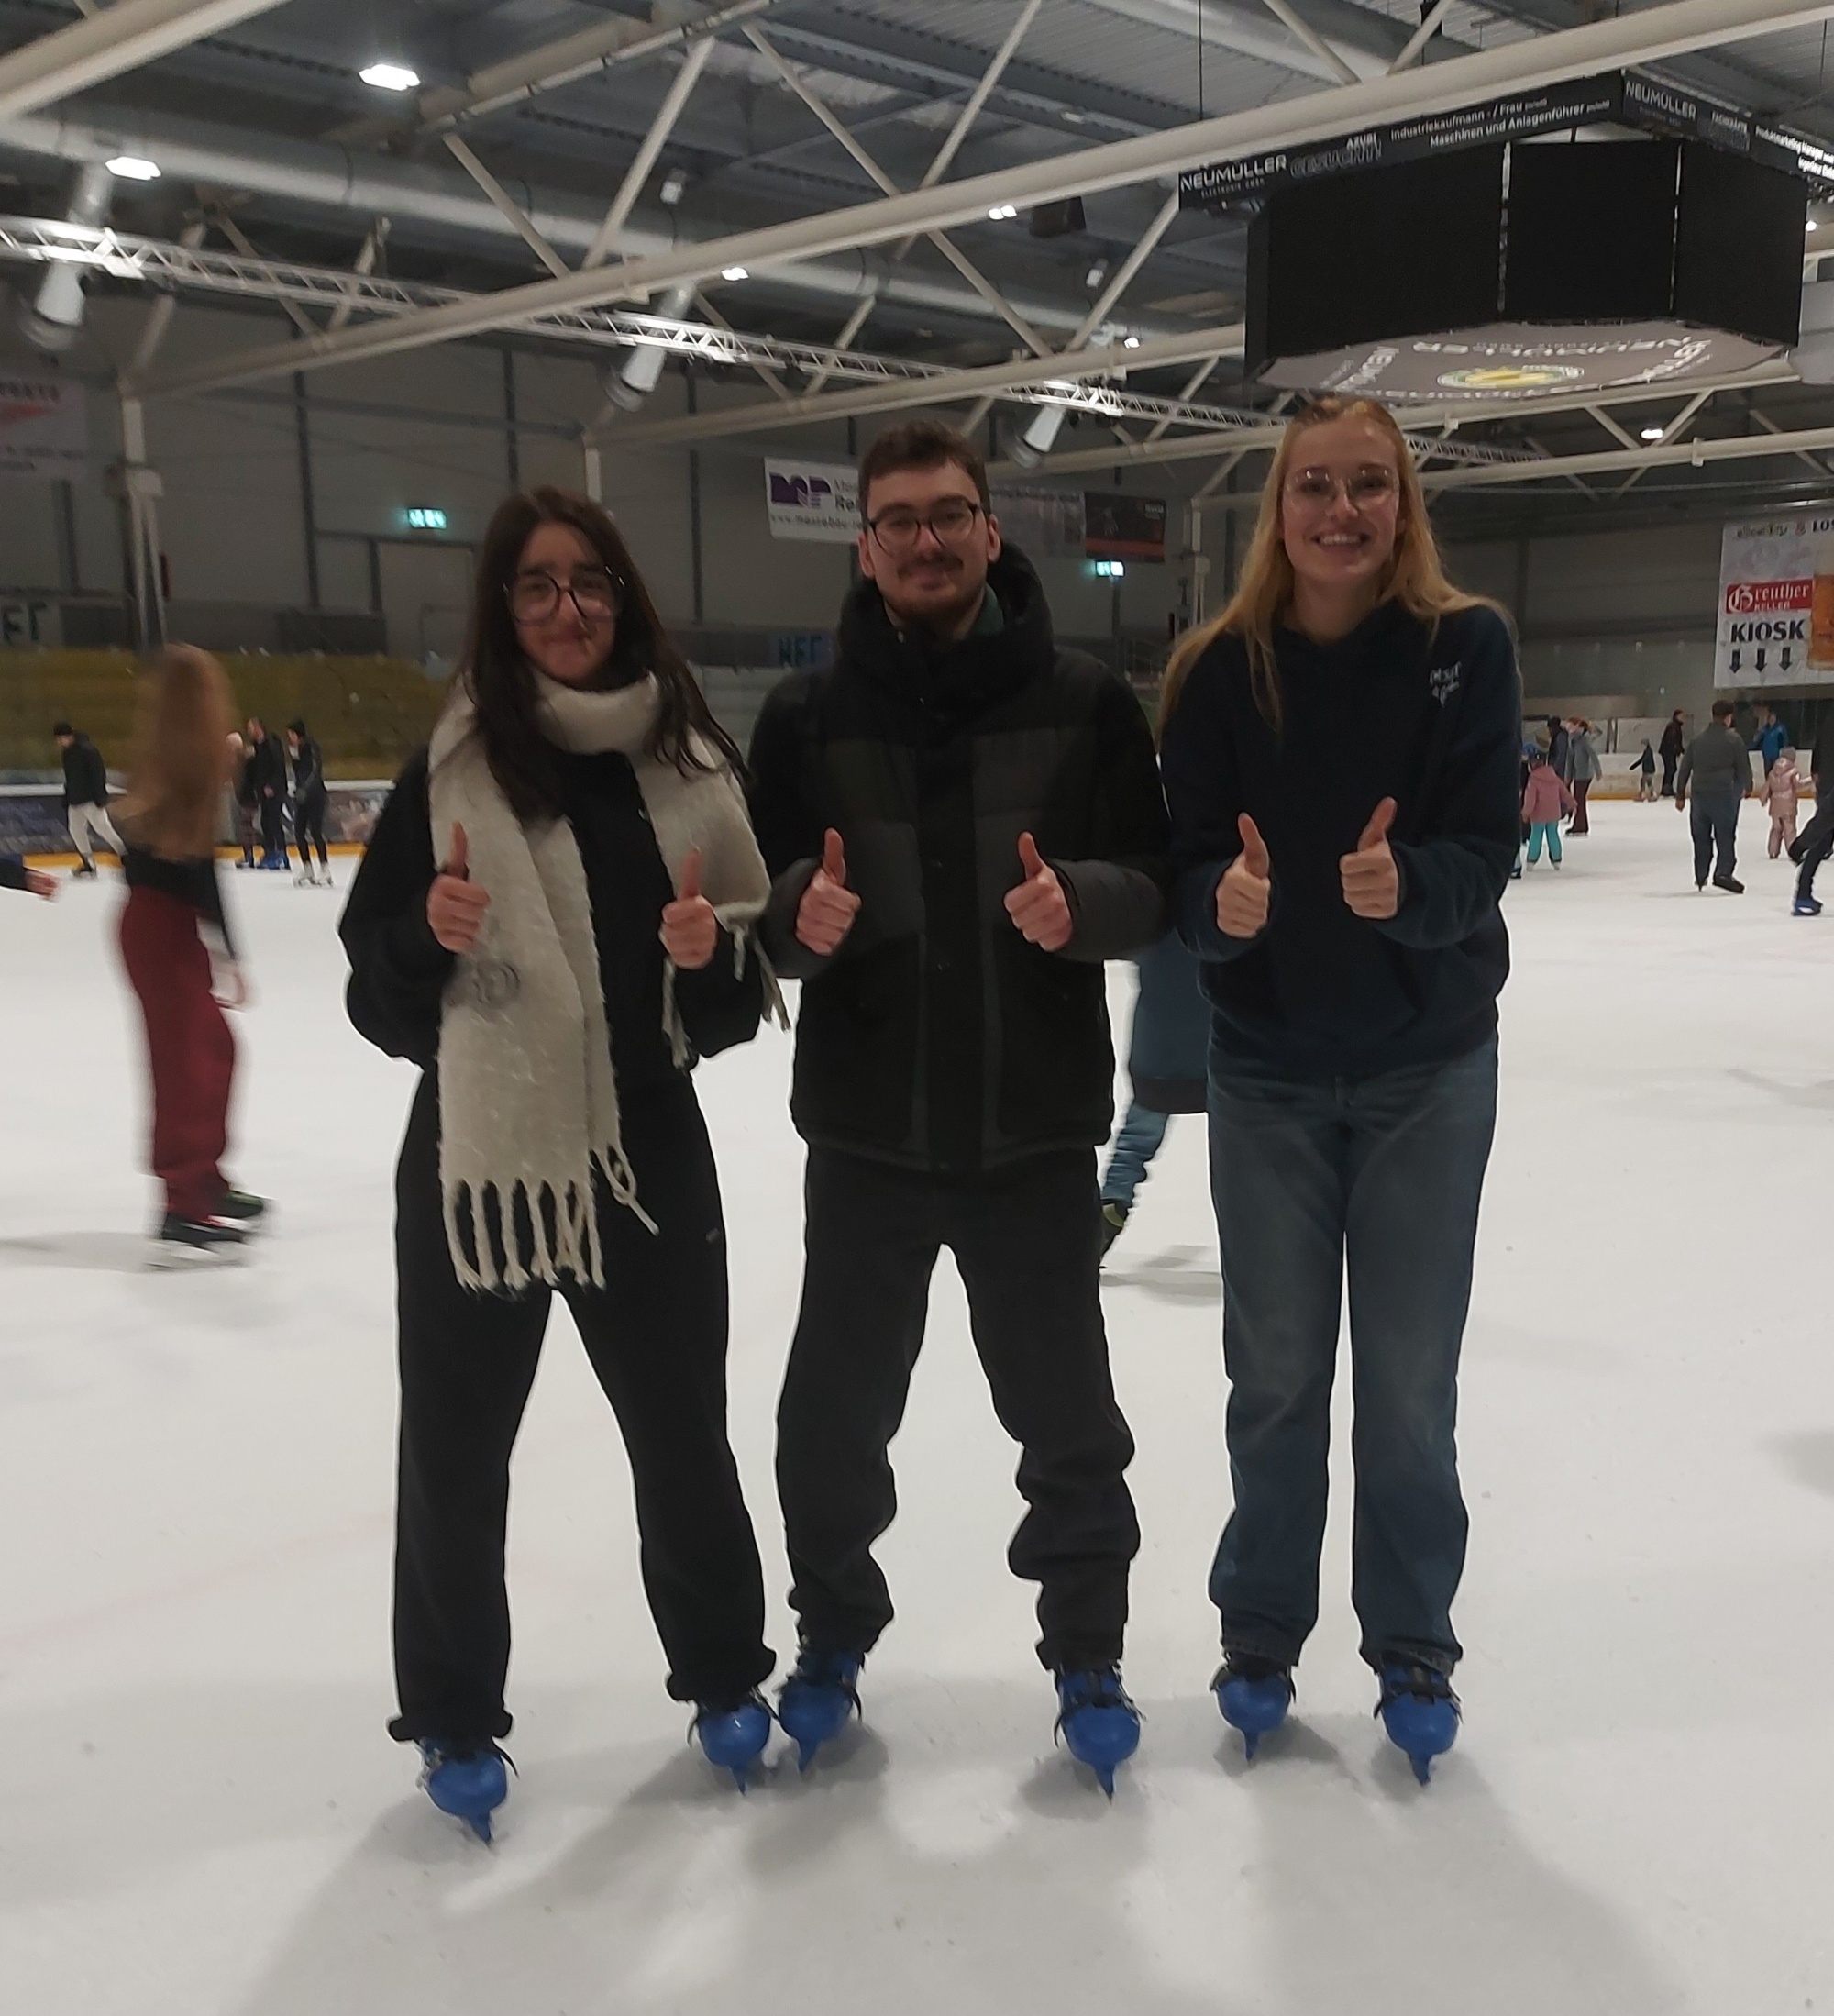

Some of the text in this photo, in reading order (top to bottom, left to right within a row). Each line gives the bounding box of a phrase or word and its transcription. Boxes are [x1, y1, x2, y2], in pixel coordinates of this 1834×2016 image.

[1390, 111, 1485, 142] Industriekaufmann
[1499, 101, 1523, 116] Frau
[1430, 126, 1484, 149] Maschinen
[1486, 120, 1507, 136] und
[1508, 104, 1585, 130] Anlagenführer
[1180, 154, 1287, 194] NEUMÜLLER
[1728, 583, 1810, 614] Greuther
[1753, 600, 1791, 613] KELLER
[1730, 618, 1806, 644] KIOSK
